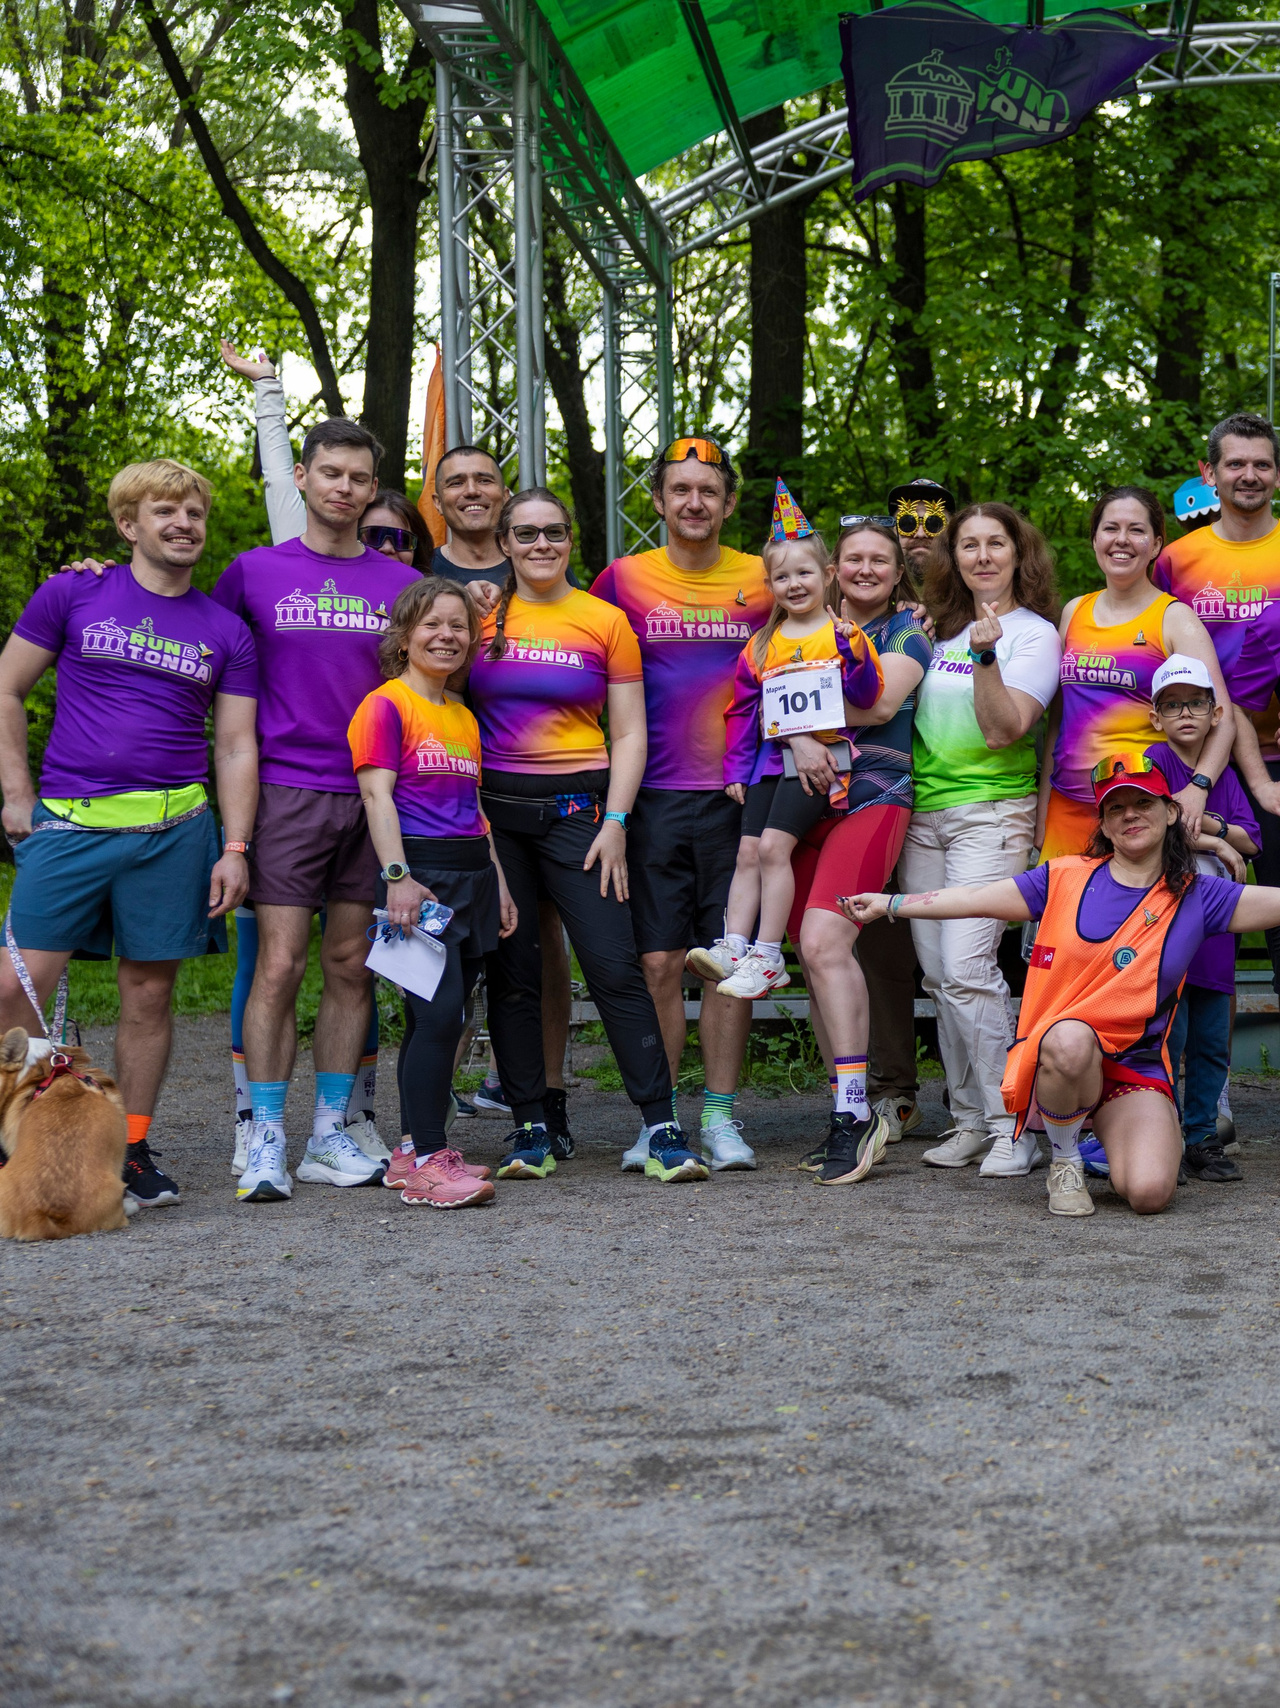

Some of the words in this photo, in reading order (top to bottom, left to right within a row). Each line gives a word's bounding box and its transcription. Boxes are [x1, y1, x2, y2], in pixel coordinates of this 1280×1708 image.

[1226, 588, 1262, 604] RUN
[318, 597, 364, 613] RUN
[683, 609, 725, 623] RUN
[683, 622, 750, 639] TONDA
[129, 632, 181, 656] RUN
[517, 637, 556, 651] RUN
[128, 644, 210, 683] TONDA
[516, 648, 582, 667] TONDA
[943, 649, 972, 662] RUN
[1077, 655, 1112, 670] RUN
[1076, 667, 1133, 688] TONDA
[765, 685, 787, 694] Мария
[779, 689, 822, 715] 101
[445, 743, 471, 760] RUN
[449, 757, 479, 776] TOND
